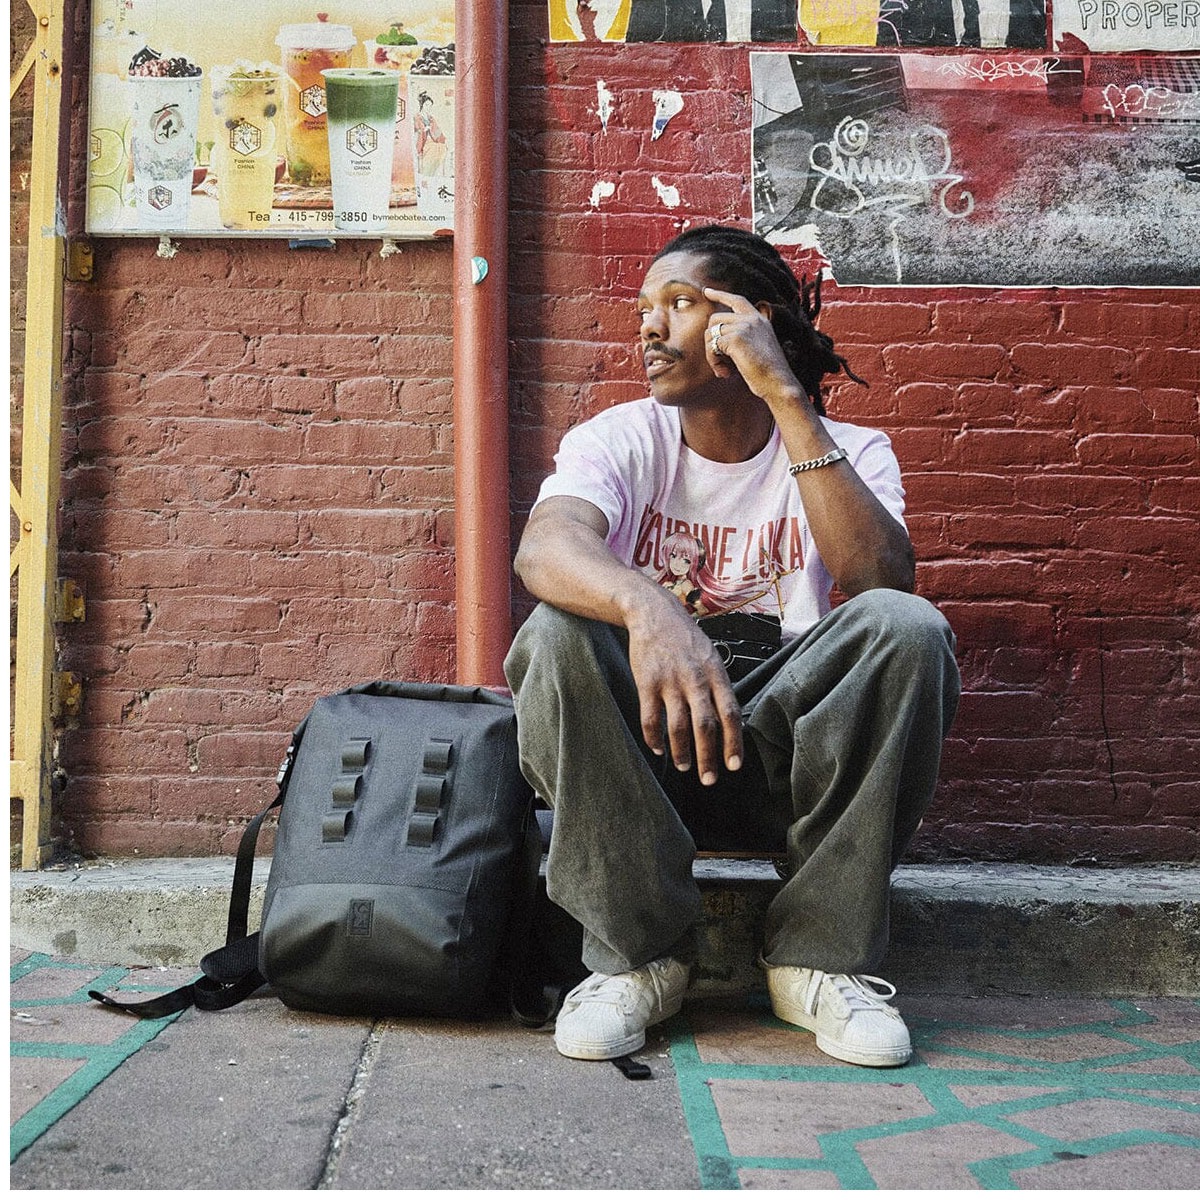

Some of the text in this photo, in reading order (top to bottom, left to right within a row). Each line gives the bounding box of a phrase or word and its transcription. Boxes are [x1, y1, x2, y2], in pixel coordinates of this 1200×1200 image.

[1079, 0, 1200, 30] PROPER
[248, 211, 270, 222] Tea
[288, 211, 368, 222] 415-799-3850
[372, 213, 446, 223] bymebobatea.com
